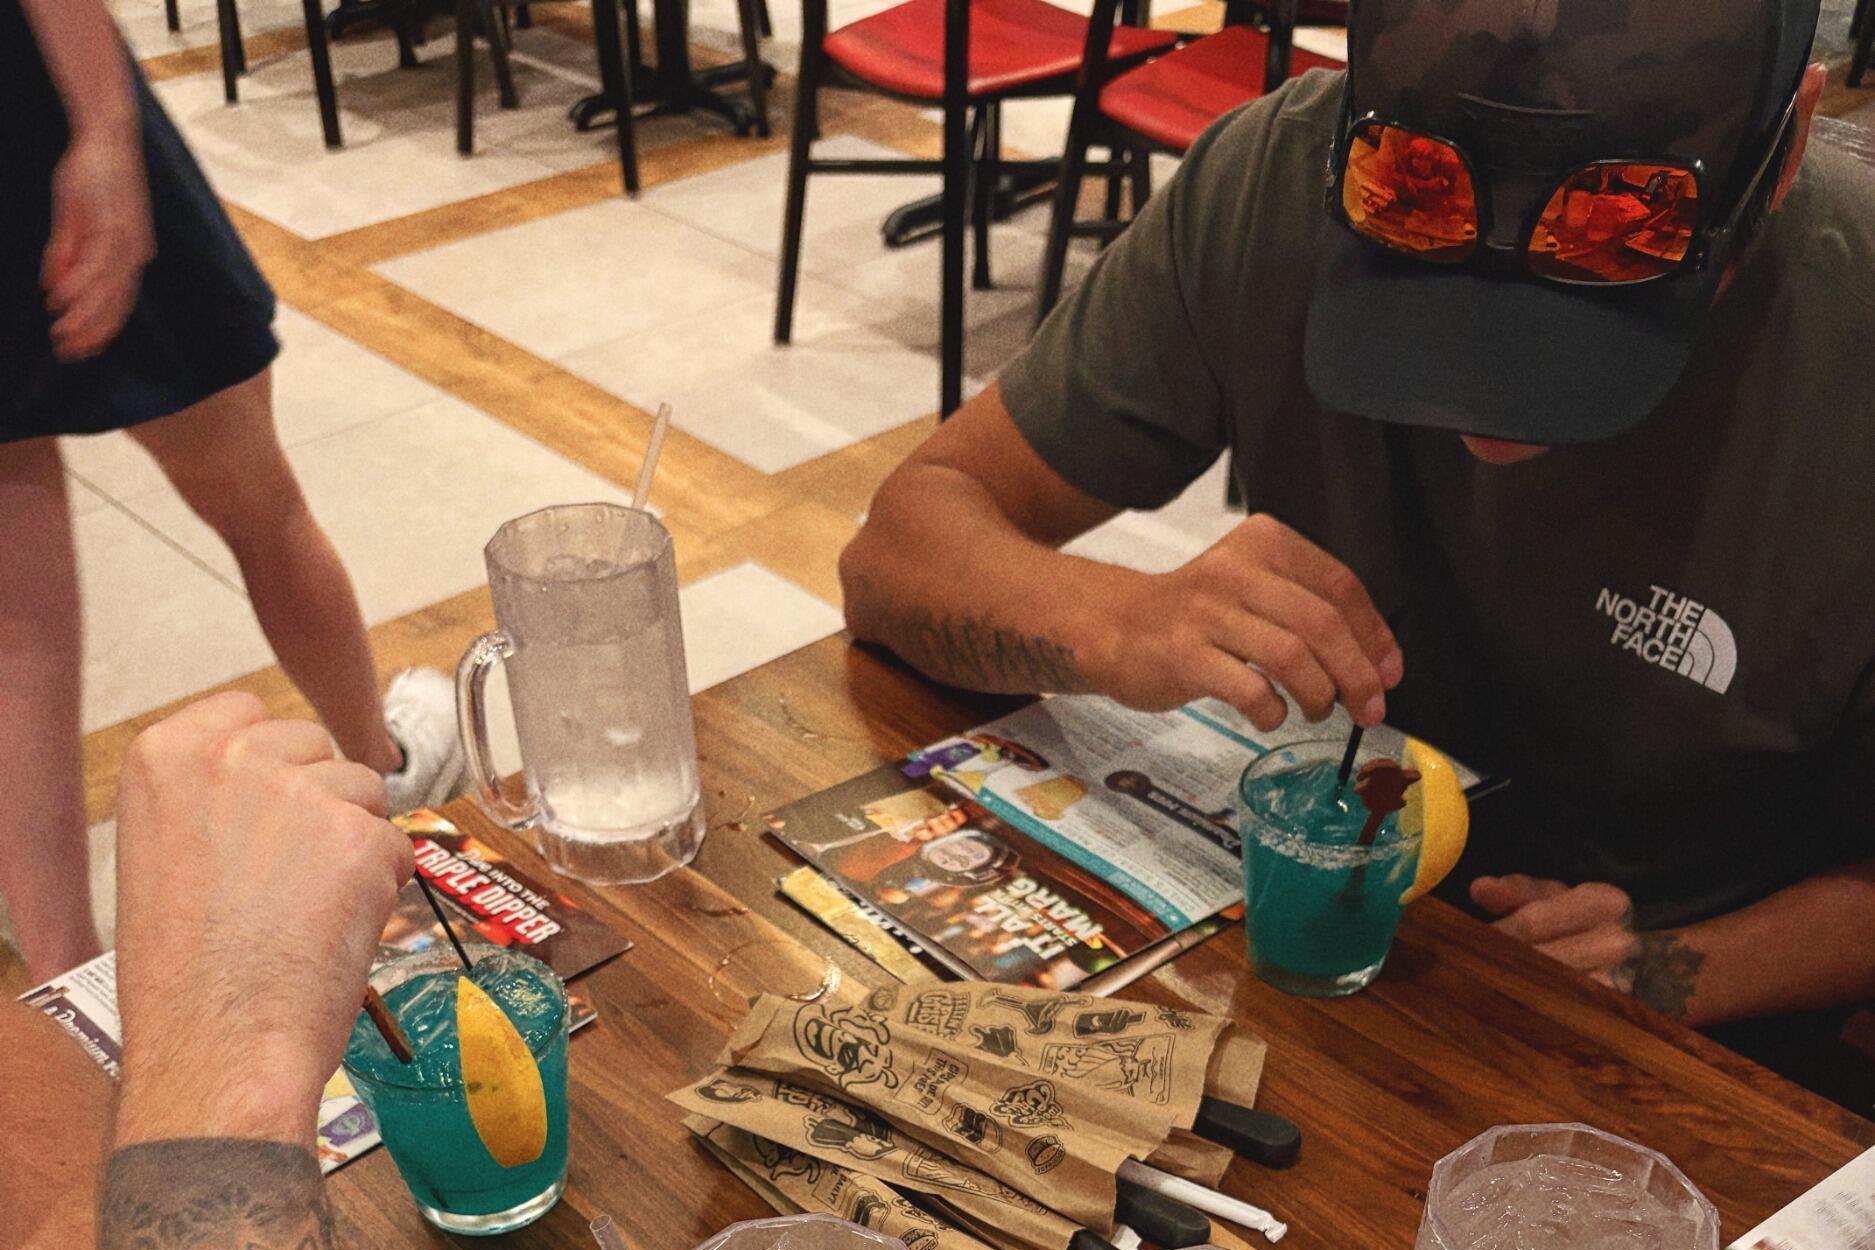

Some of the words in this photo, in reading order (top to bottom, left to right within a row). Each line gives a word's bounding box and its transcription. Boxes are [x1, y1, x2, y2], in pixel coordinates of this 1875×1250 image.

[1595, 587, 1696, 650] NORTH
[1650, 584, 1704, 628] THE
[1610, 623, 1684, 671] FACE
[415, 838, 490, 895] TRIPLE
[471, 882, 562, 944] DIPPER
[488, 868, 524, 893] INTO
[519, 887, 550, 911] THE
[1005, 876, 1104, 941] MARG
